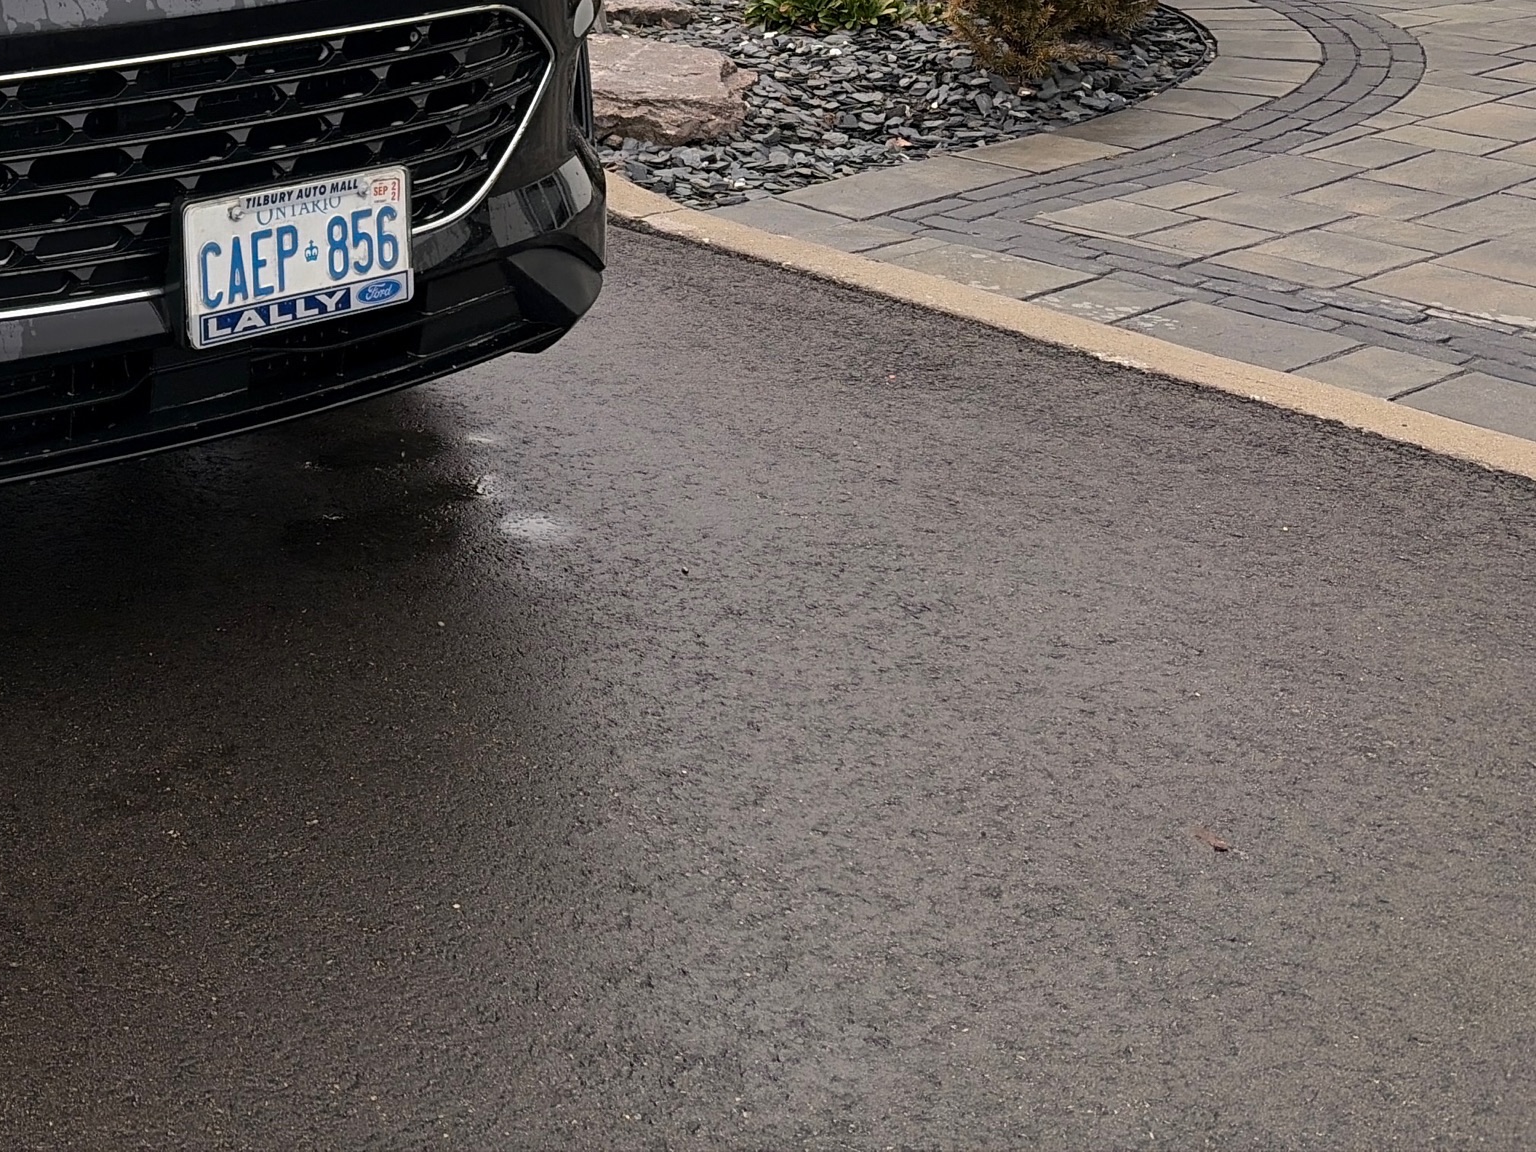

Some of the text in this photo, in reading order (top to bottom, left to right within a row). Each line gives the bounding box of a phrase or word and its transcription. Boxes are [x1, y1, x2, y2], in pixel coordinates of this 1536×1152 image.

[246, 178, 359, 209] TILBURY AUTO MALL
[373, 185, 389, 197] SEP
[256, 195, 341, 226] ONTARIO
[200, 205, 400, 309] CAEP 856
[207, 282, 393, 338] LALLY Ford
